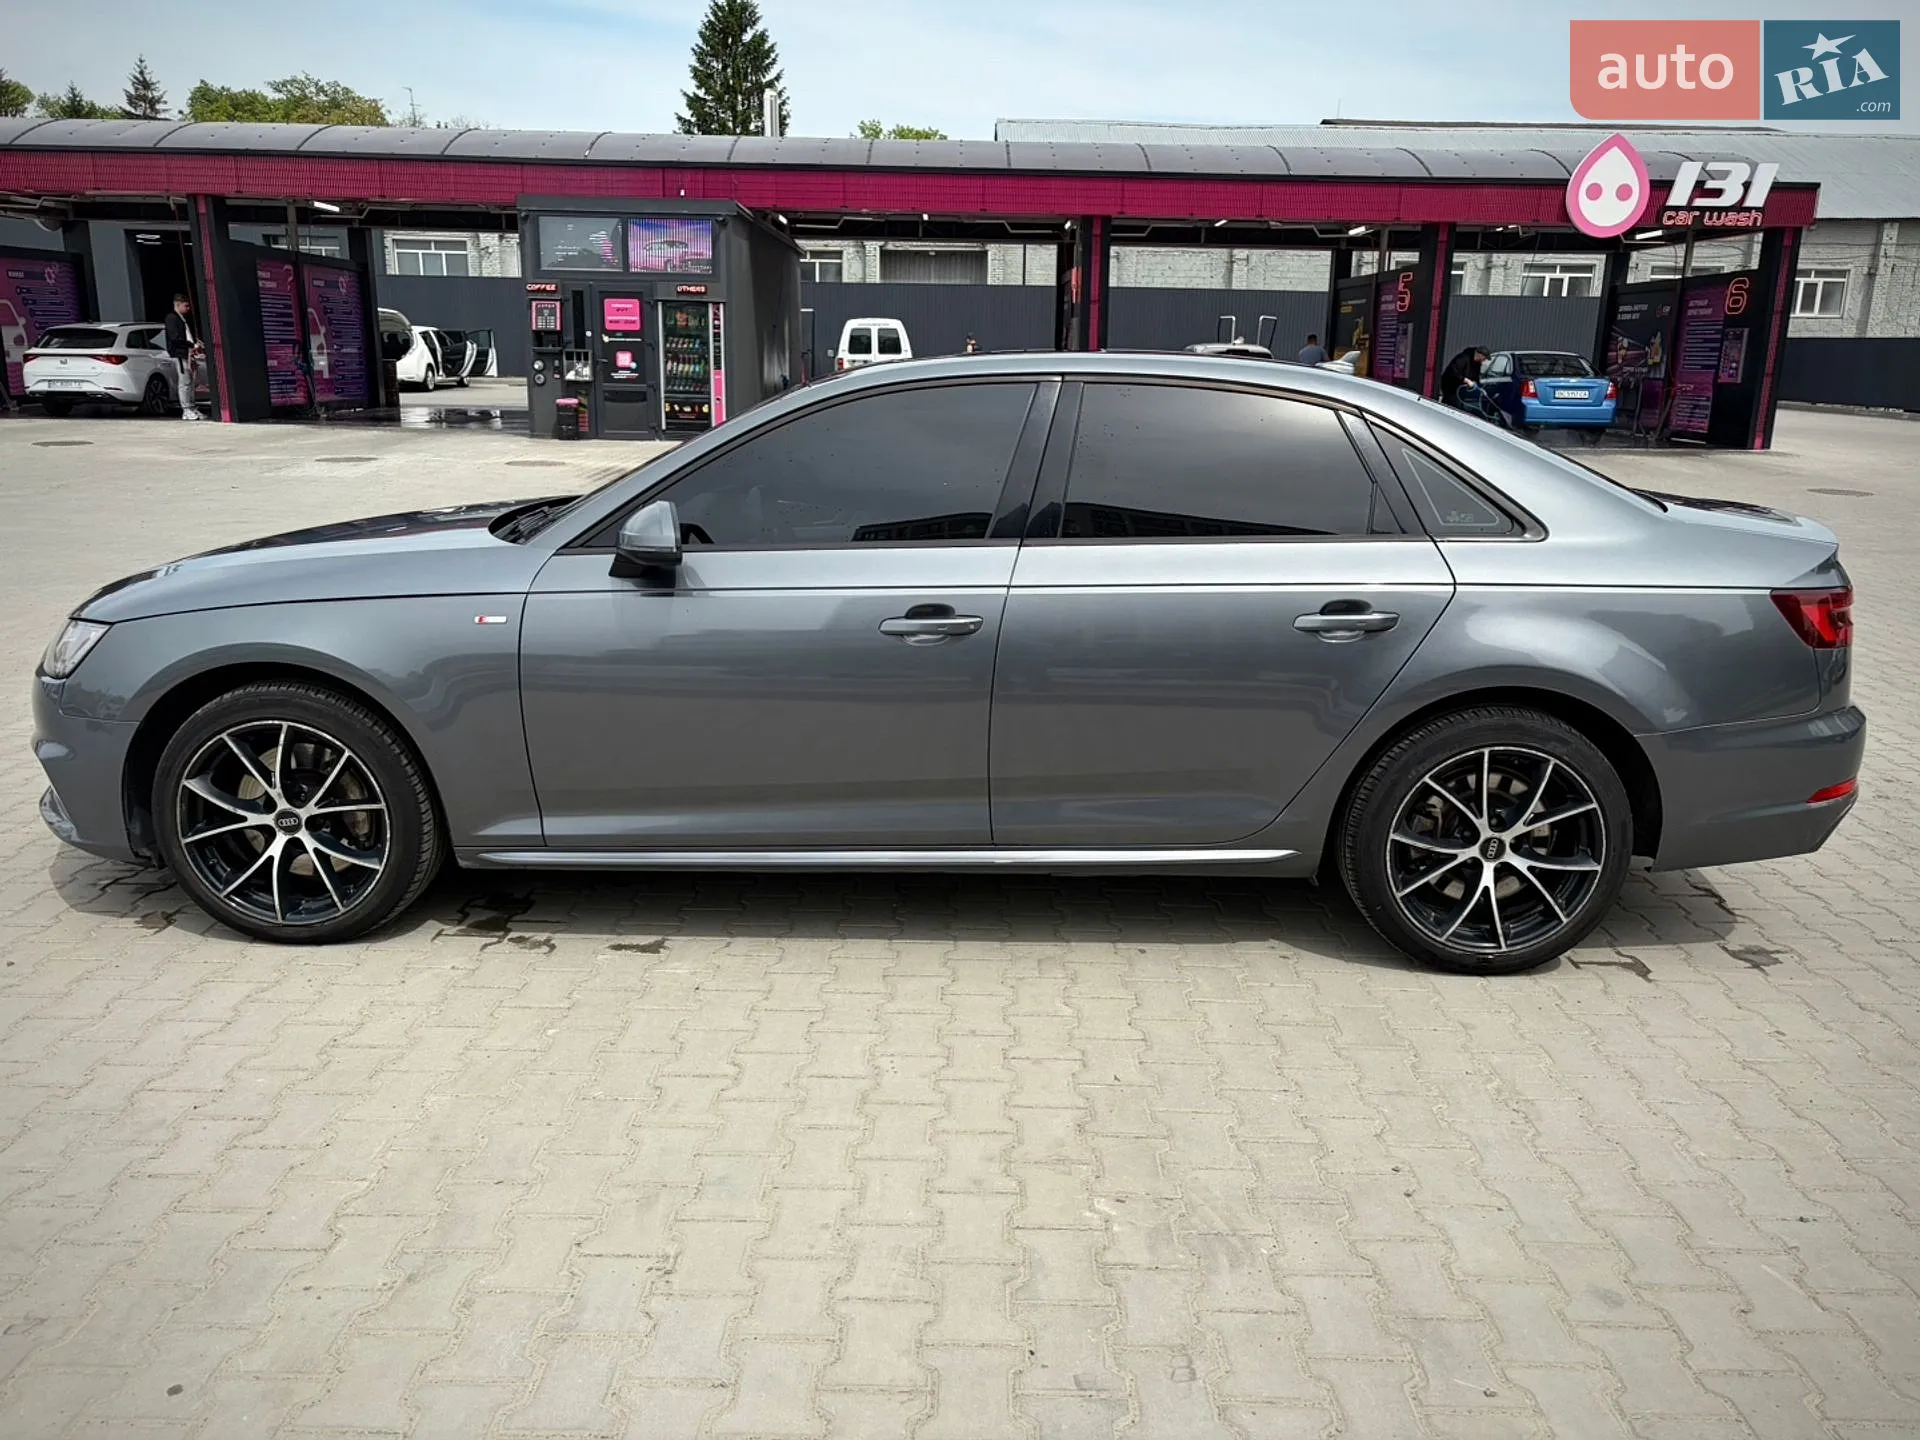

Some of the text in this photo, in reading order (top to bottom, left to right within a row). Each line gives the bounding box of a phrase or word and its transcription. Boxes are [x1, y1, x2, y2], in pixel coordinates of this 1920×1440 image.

[1663, 161, 1780, 208] 131
[1661, 209, 1763, 227] car wash
[525, 283, 557, 291] COFFEE
[676, 284, 706, 293] OTHERS
[1396, 272, 1414, 312] 5
[1724, 277, 1750, 315] 6
